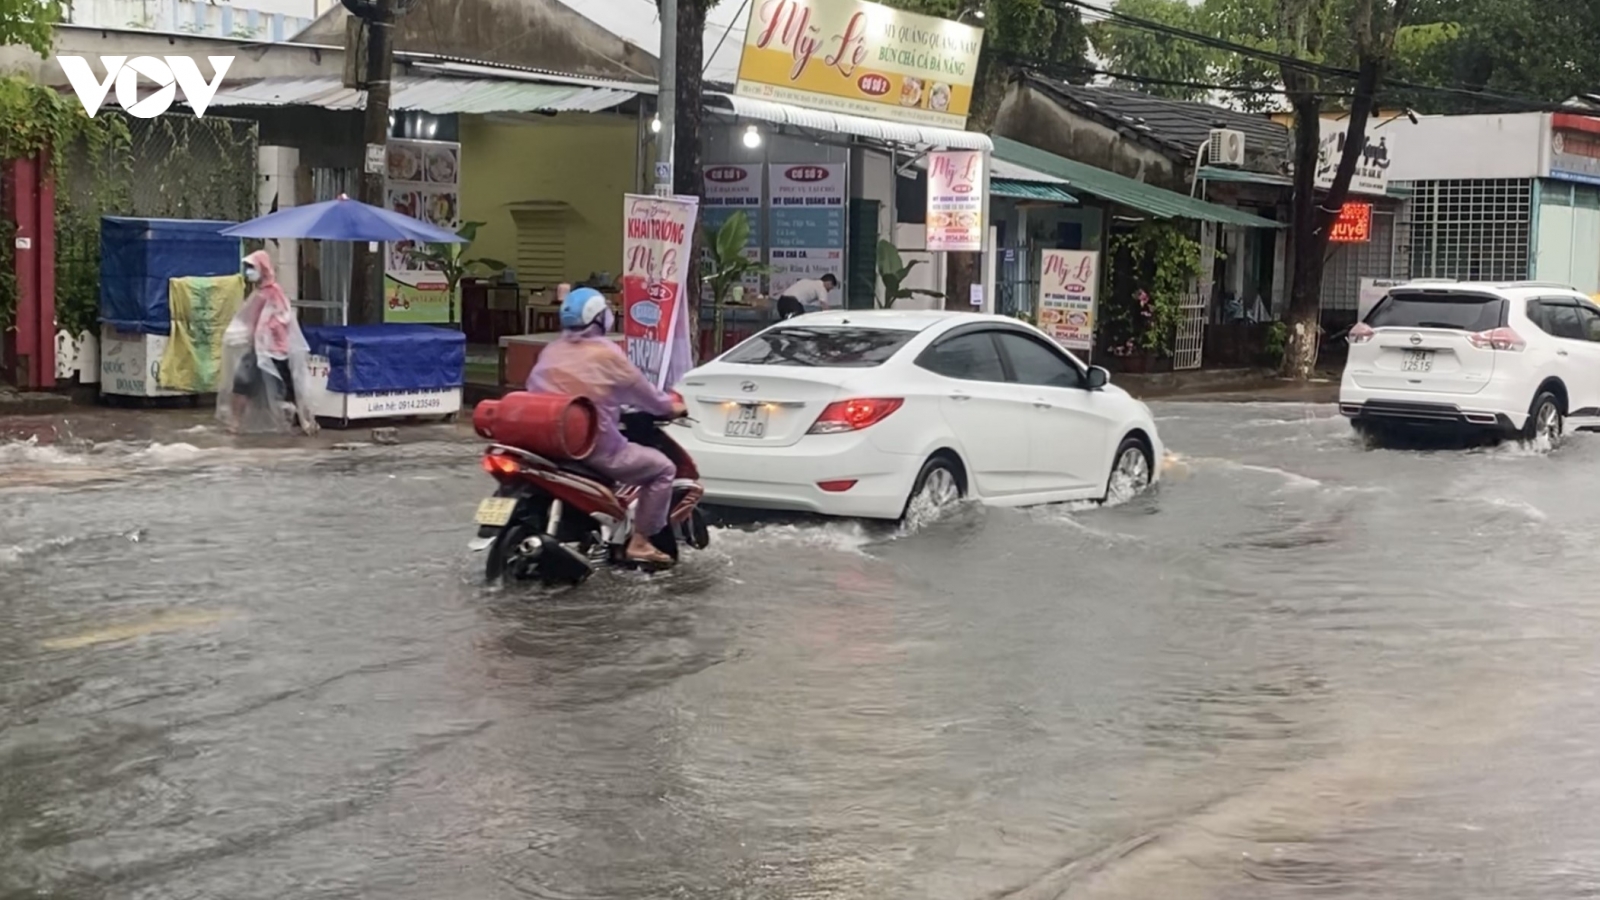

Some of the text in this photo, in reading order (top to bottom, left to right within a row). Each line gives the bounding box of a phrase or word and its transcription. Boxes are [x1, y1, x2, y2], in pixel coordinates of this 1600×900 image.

[757, 0, 823, 81] Mỹ
[880, 80, 887, 92] 2
[817, 169, 823, 179] 2
[827, 197, 841, 205] NAM
[627, 218, 650, 239] KHAI
[368, 401, 385, 412] Liên
